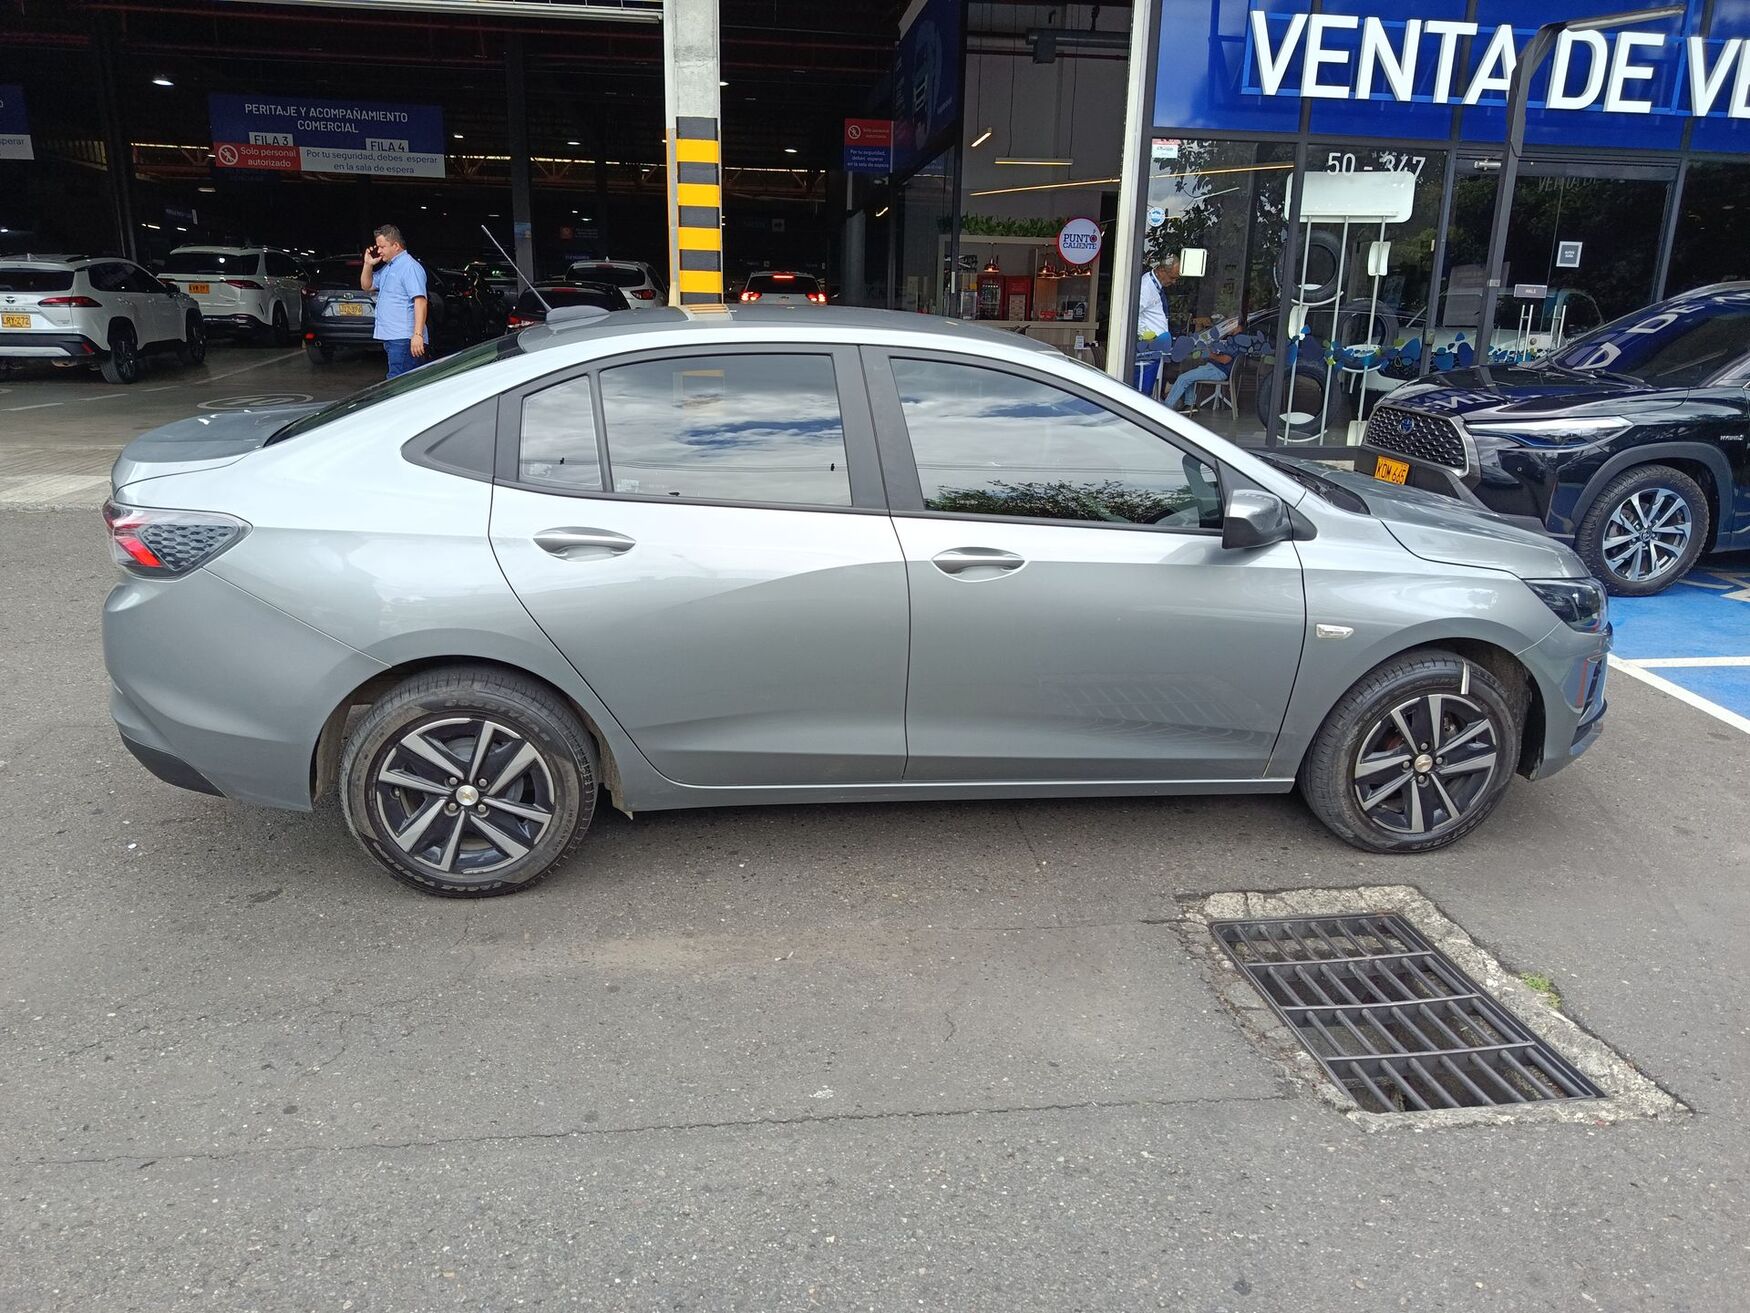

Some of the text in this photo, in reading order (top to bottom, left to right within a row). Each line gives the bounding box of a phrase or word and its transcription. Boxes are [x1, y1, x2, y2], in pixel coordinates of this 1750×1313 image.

[1250, 9, 1517, 105] VENTA
[1546, 28, 1666, 114] DE
[245, 103, 409, 123] PERITAJE Y ACOMPAÑAMIENTO
[297, 120, 360, 133] COMERCIAL
[254, 134, 290, 146] FILA 3
[370, 140, 406, 152] FILA 4
[240, 146, 297, 159] Solo personal
[306, 149, 321, 158] Por
[321, 151, 331, 159] tu
[376, 153, 403, 162] debes
[406, 156, 438, 166] esperar
[247, 159, 292, 168] autorizado
[346, 163, 354, 171] la
[355, 163, 372, 172] sala
[373, 164, 385, 173] de
[386, 165, 415, 175] espera
[1326, 152, 1356, 176] 50
[1063, 233, 1098, 243] PUNTO
